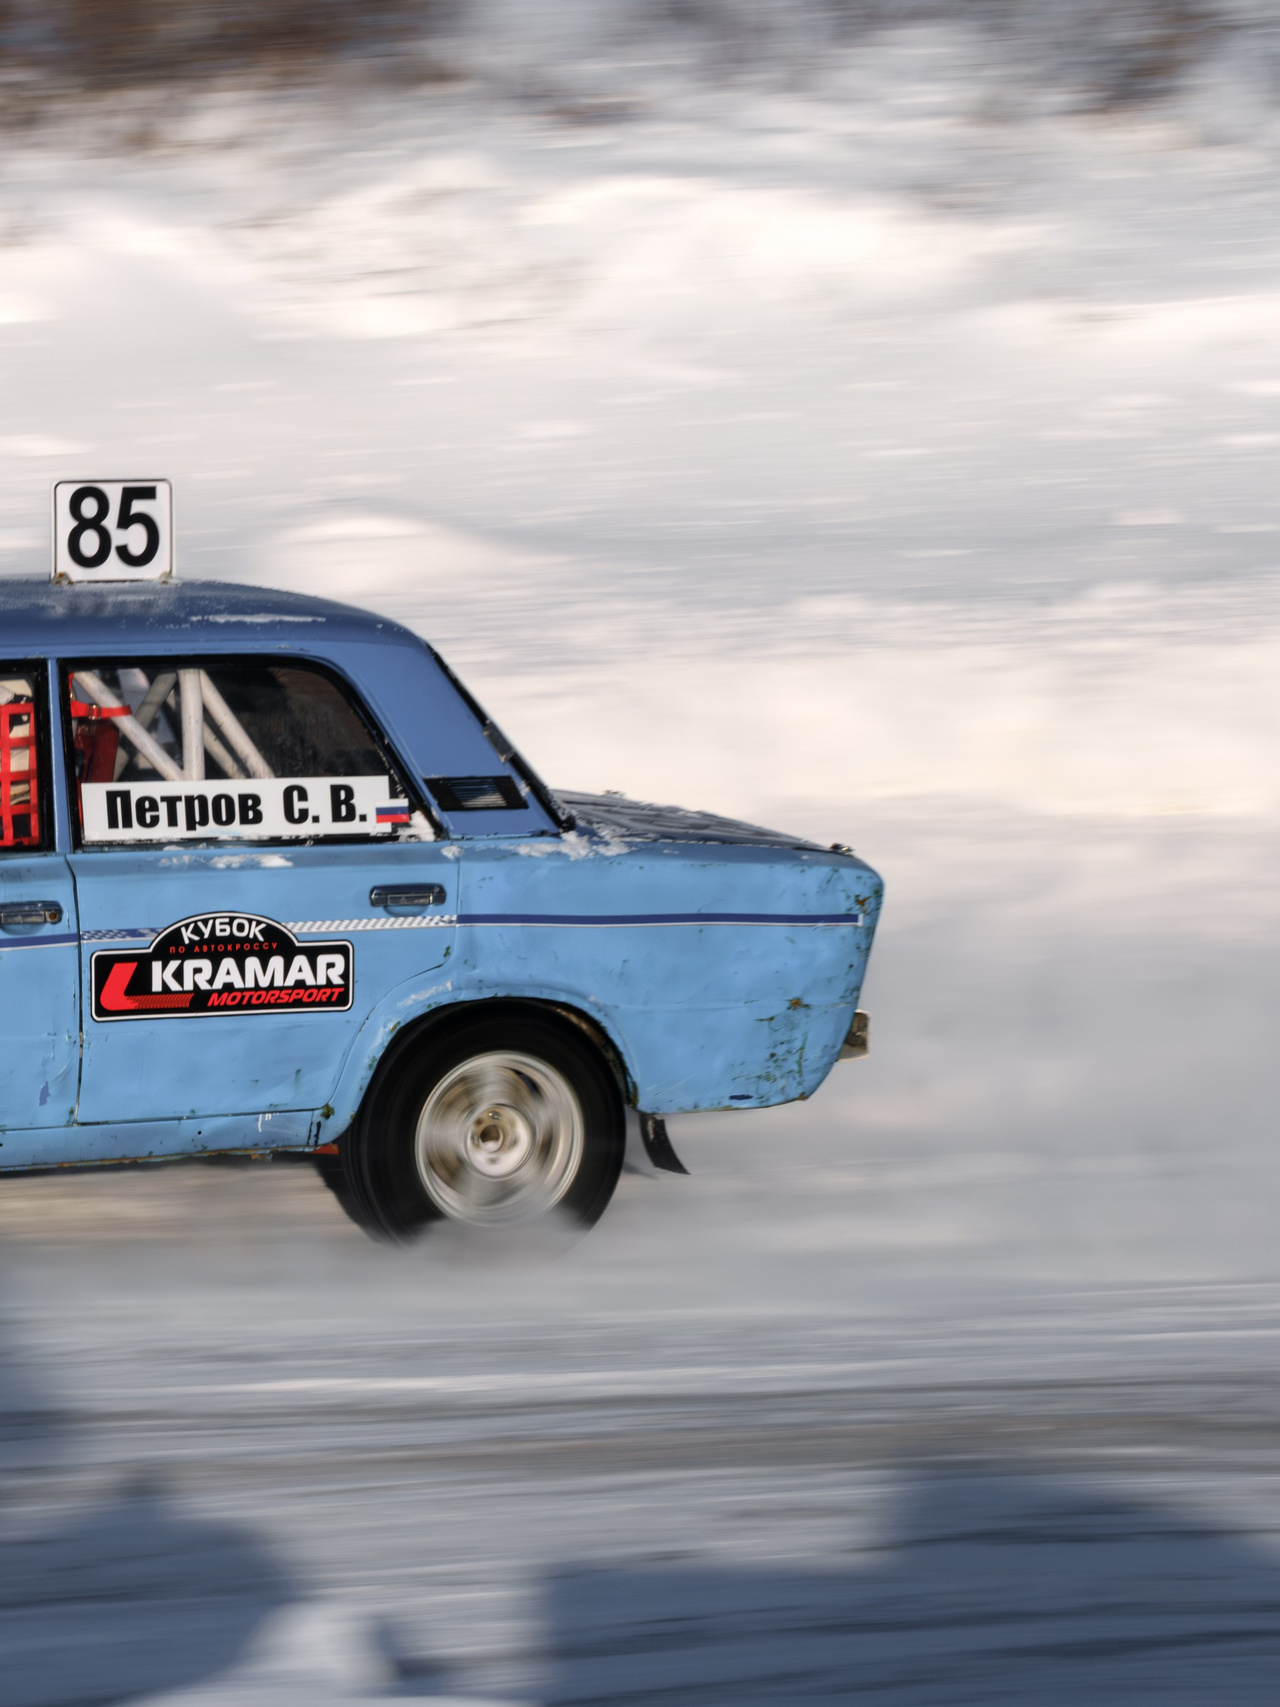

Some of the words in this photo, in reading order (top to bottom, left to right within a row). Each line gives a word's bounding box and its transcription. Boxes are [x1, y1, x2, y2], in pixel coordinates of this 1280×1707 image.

[67, 485, 160, 569] 85
[105, 789, 264, 832] Петров
[282, 784, 321, 825] С.
[329, 784, 368, 825] В.
[180, 917, 267, 945] КУБОК
[170, 945, 186, 954] ПО
[194, 942, 278, 954] АВТОКРОССУ
[151, 954, 346, 993] KRAMAR
[207, 987, 345, 1008] MOTORSPORT
